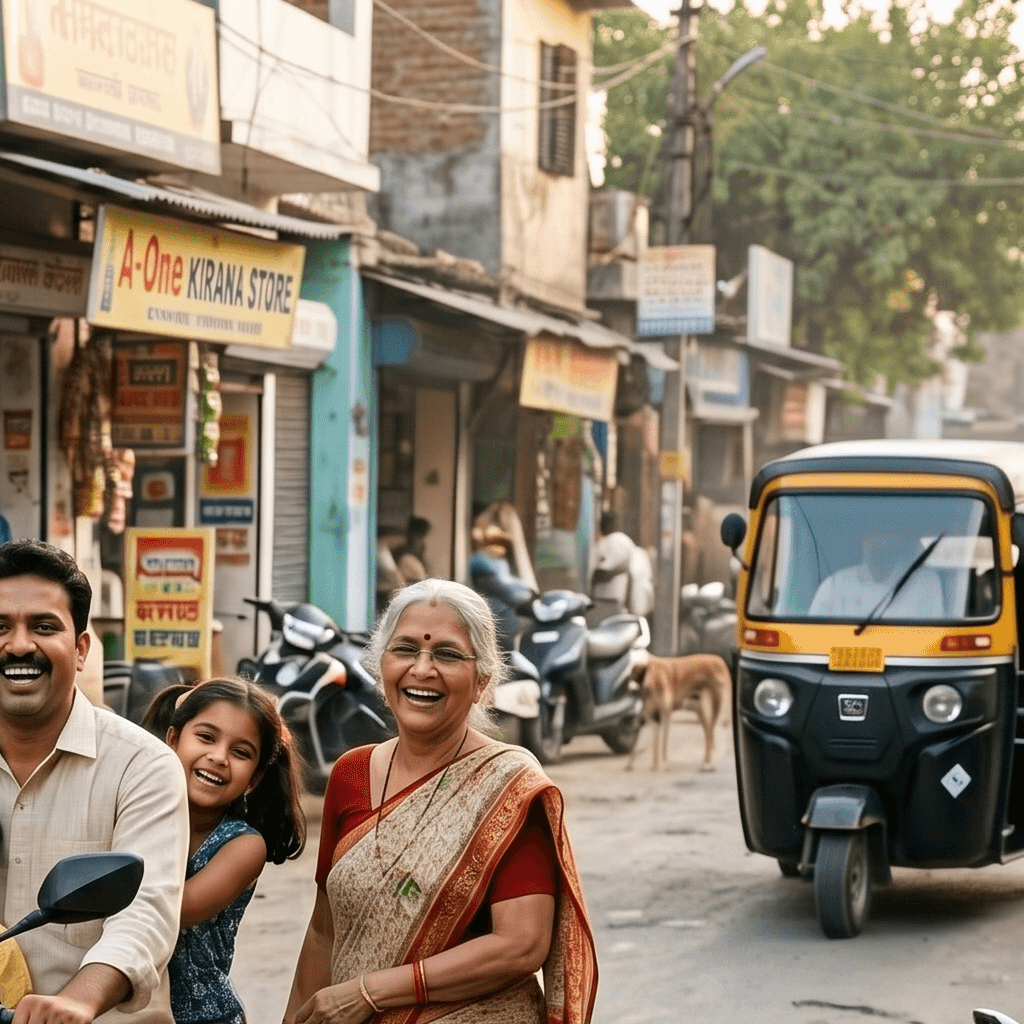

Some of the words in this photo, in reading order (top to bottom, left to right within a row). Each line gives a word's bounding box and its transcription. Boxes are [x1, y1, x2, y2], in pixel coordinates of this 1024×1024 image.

[118, 229, 183, 296] A-One
[187, 257, 244, 307] KIRANA
[248, 267, 293, 314] STORE
